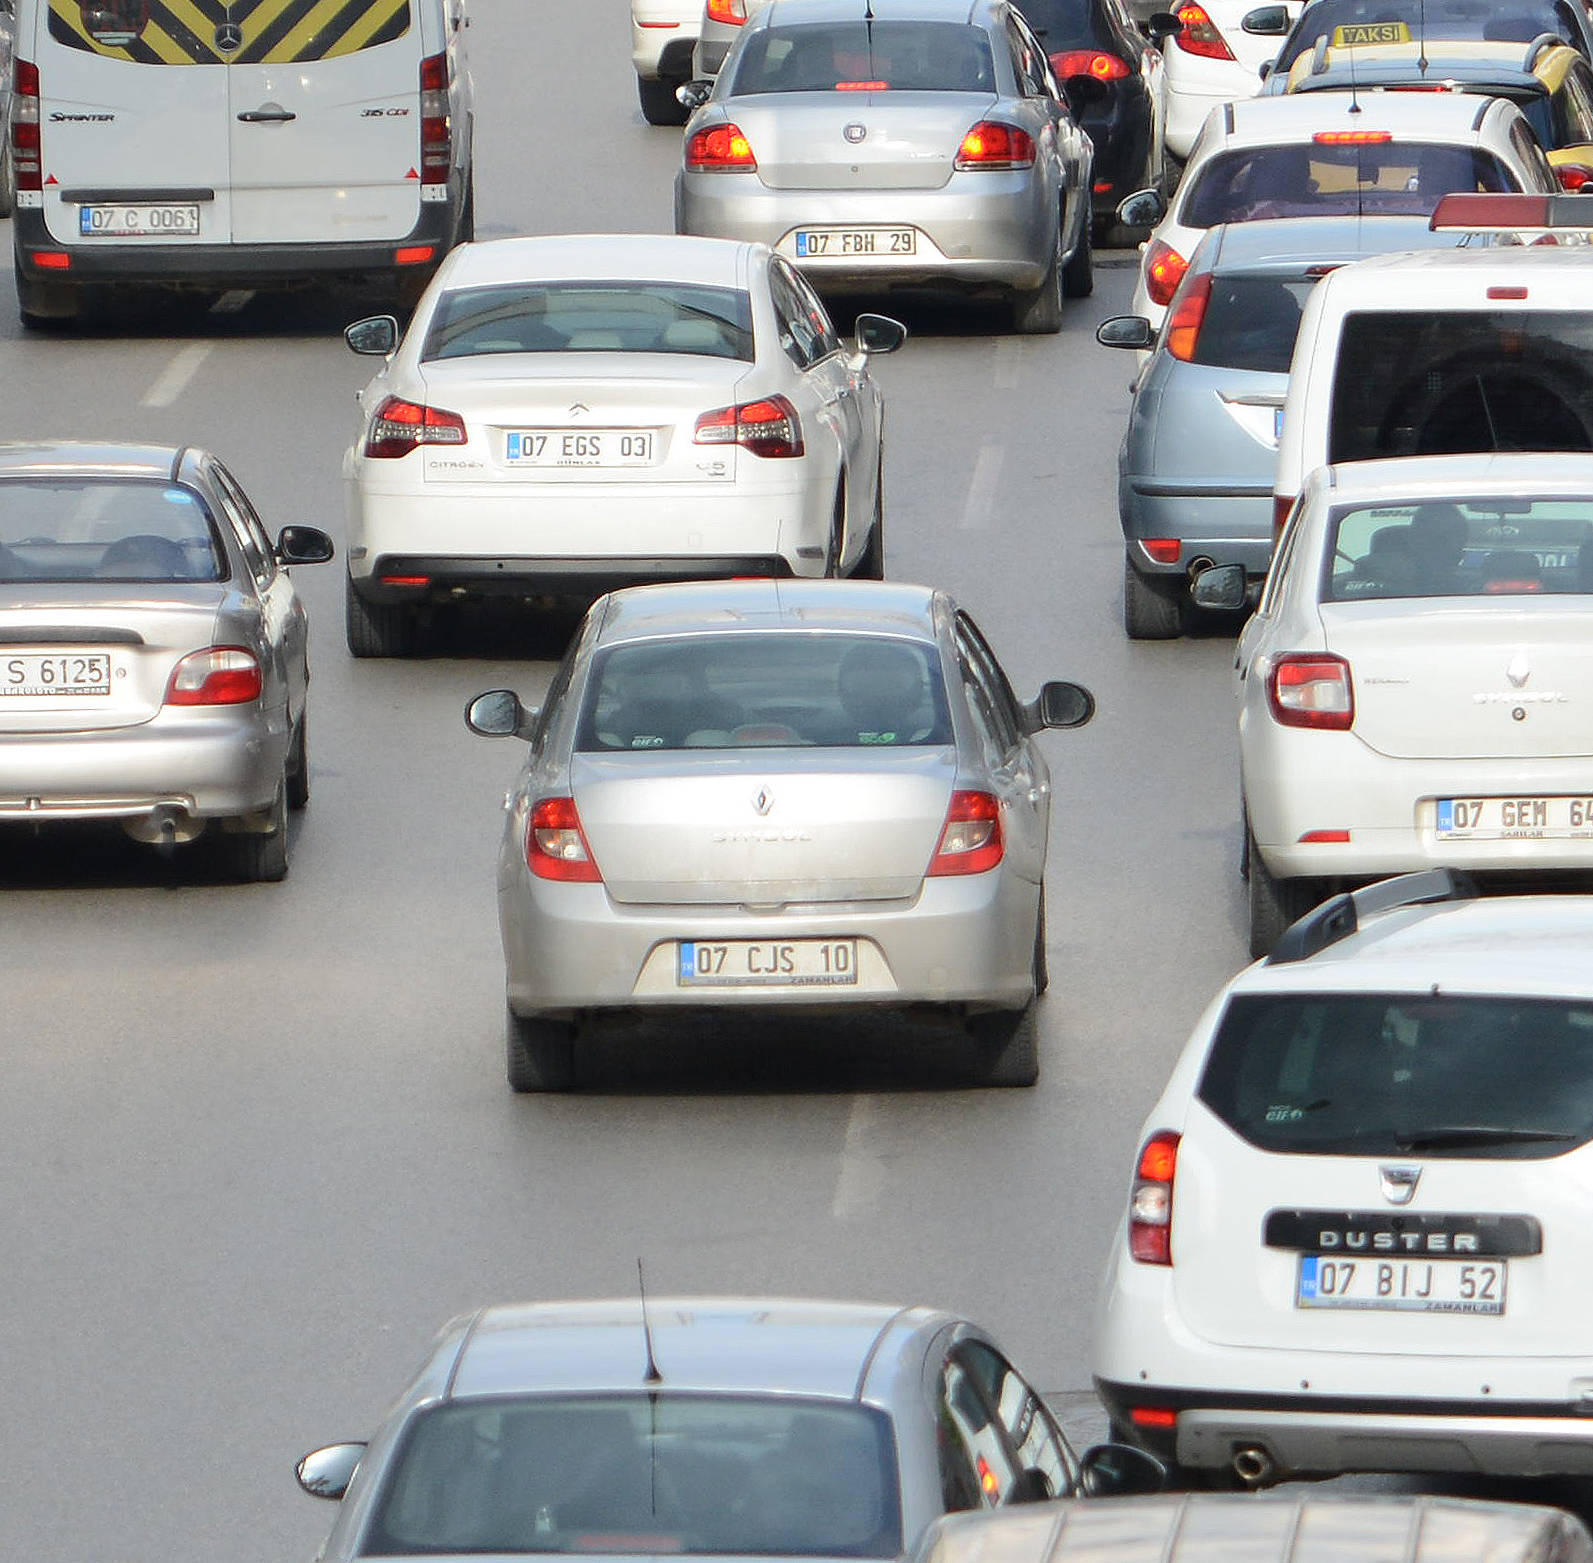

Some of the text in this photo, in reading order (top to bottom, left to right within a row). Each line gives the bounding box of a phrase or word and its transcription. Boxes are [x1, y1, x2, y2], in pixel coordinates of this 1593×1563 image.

[91, 208, 113, 229] 07
[124, 209, 139, 228] C
[808, 233, 912, 254] 07 FBH 29
[522, 435, 647, 457] 07 EGS 03
[7, 660, 26, 685] S
[40, 658, 104, 685] 6125
[1454, 800, 1484, 829] 07
[1501, 800, 1548, 828] GEM
[698, 946, 729, 974] 07
[747, 945, 795, 974] CJS
[820, 944, 849, 973] 10
[1319, 1230, 1480, 1251] DUSTER
[1320, 1262, 1356, 1296] 07
[1377, 1263, 1433, 1298] BIJ
[1459, 1265, 1497, 1301] 52
